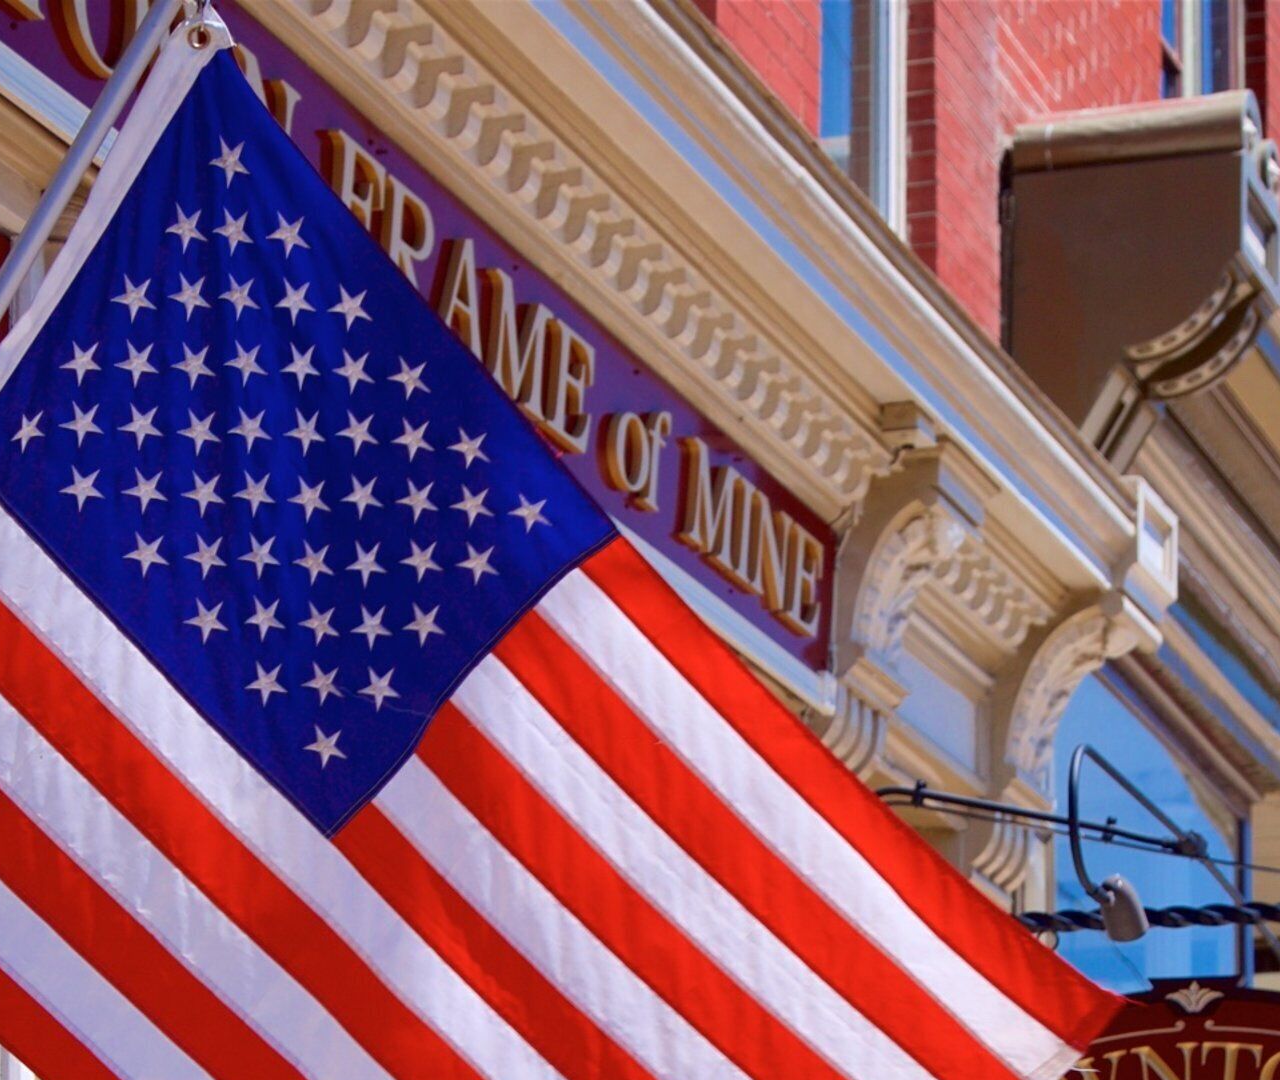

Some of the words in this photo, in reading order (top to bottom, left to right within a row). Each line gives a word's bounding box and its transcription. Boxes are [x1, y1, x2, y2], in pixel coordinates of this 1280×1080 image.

[318, 128, 596, 454] FRAME
[604, 411, 671, 512] of
[675, 435, 824, 638] MINE
